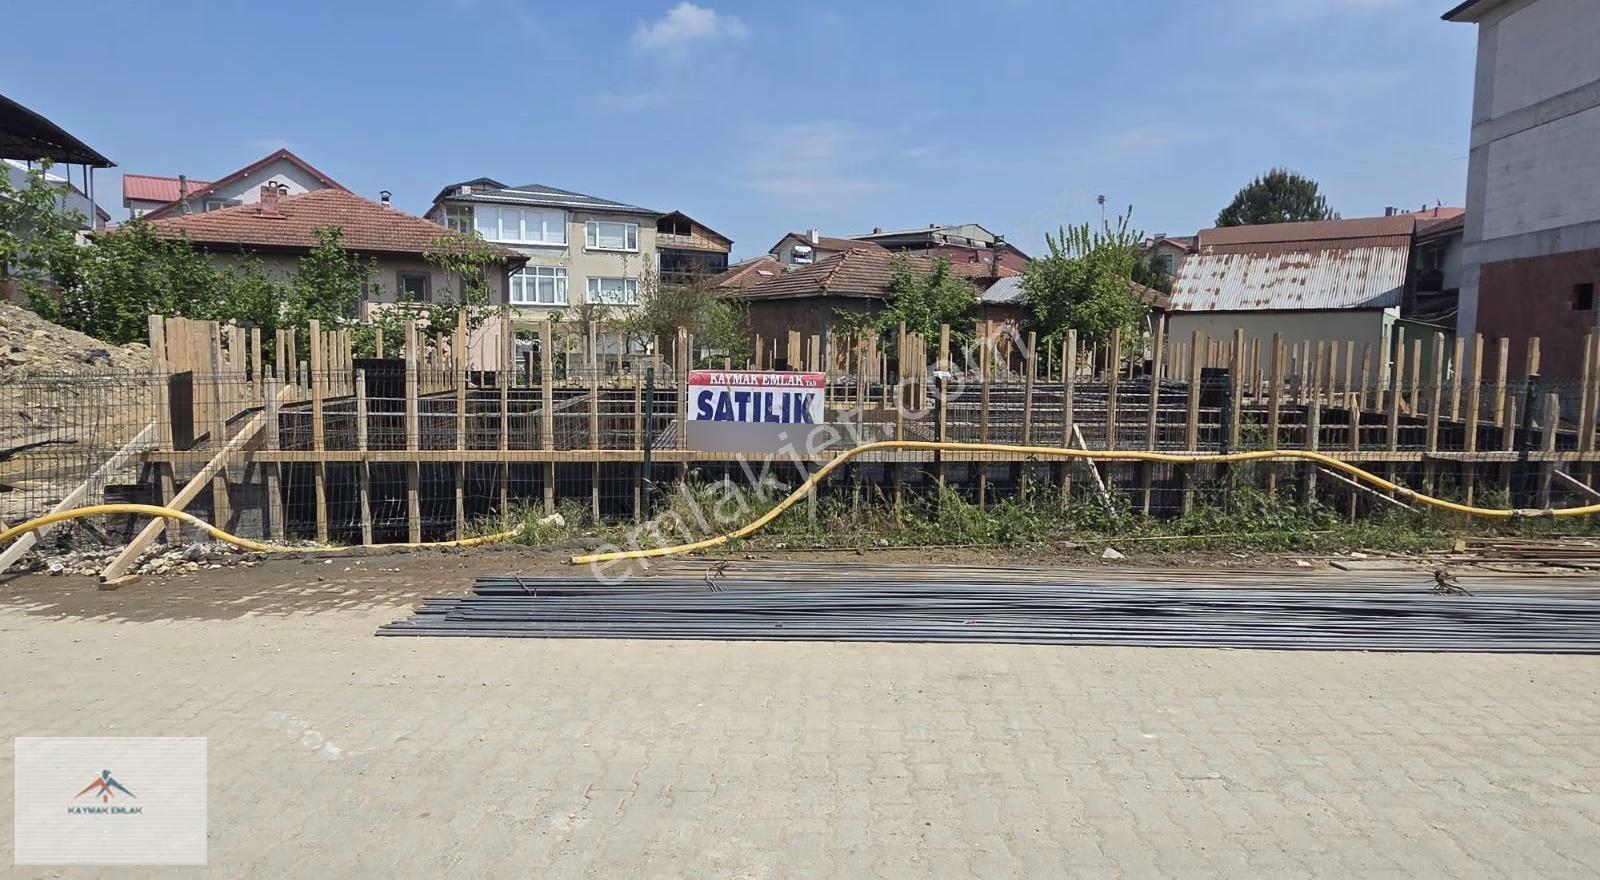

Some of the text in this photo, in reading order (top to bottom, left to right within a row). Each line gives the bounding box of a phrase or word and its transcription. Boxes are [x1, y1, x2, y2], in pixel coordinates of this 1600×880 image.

[710, 373, 759, 385] KAYMAK
[763, 374, 804, 386] EMLAK
[696, 390, 815, 424] SATILIK
